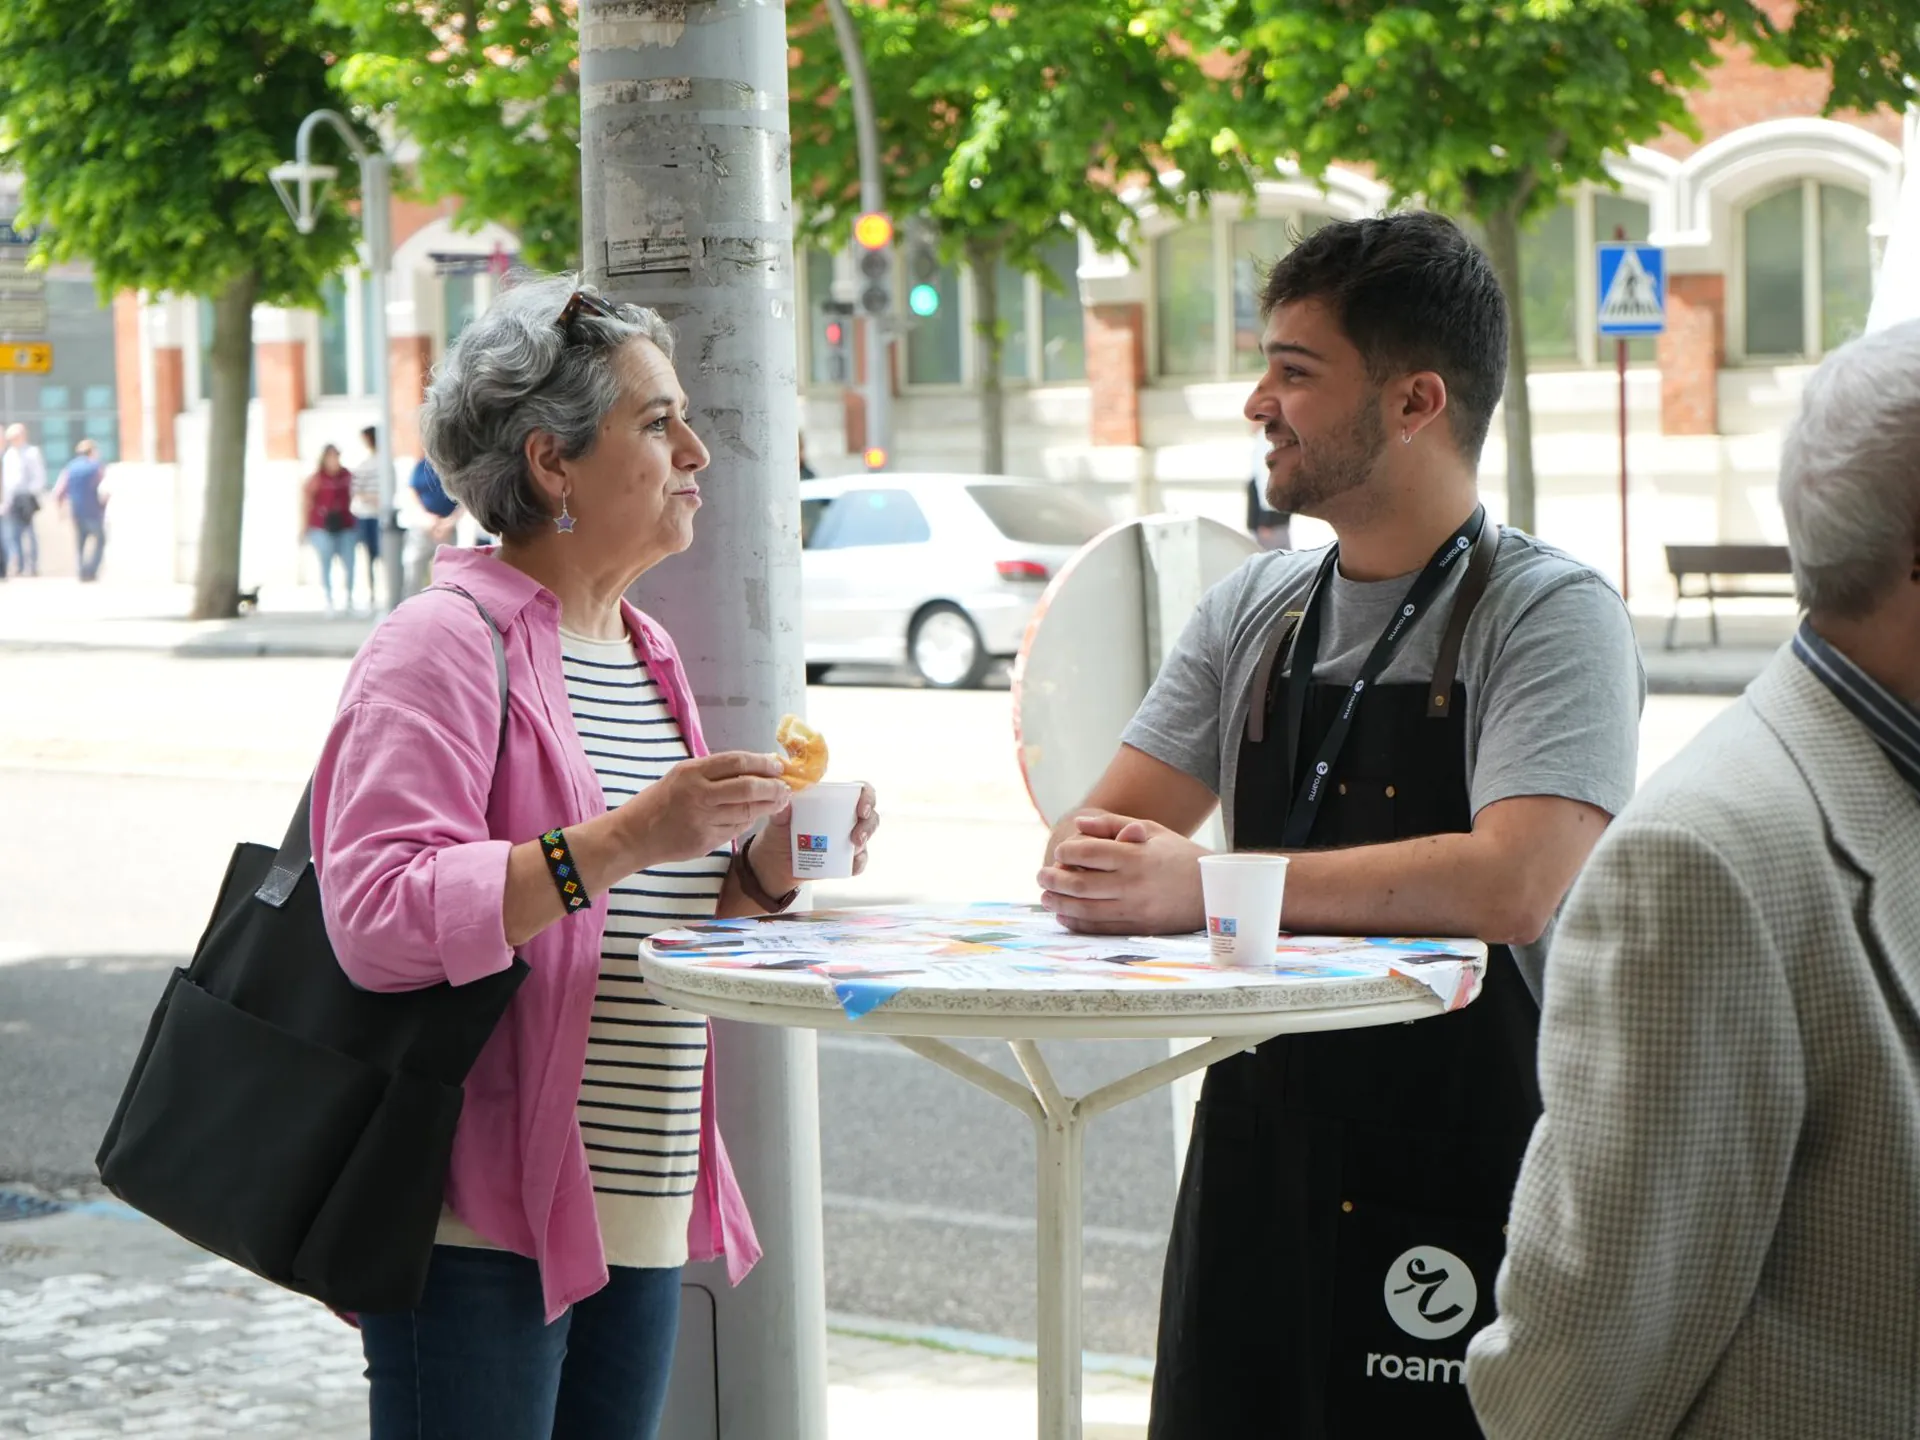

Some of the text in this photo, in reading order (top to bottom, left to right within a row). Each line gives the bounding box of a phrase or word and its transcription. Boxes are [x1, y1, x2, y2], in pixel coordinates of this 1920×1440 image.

[1439, 546, 1460, 568] roams
[1387, 616, 1407, 641] roams
[1308, 775, 1322, 802] roams
[1366, 1352, 1466, 1385] roam
